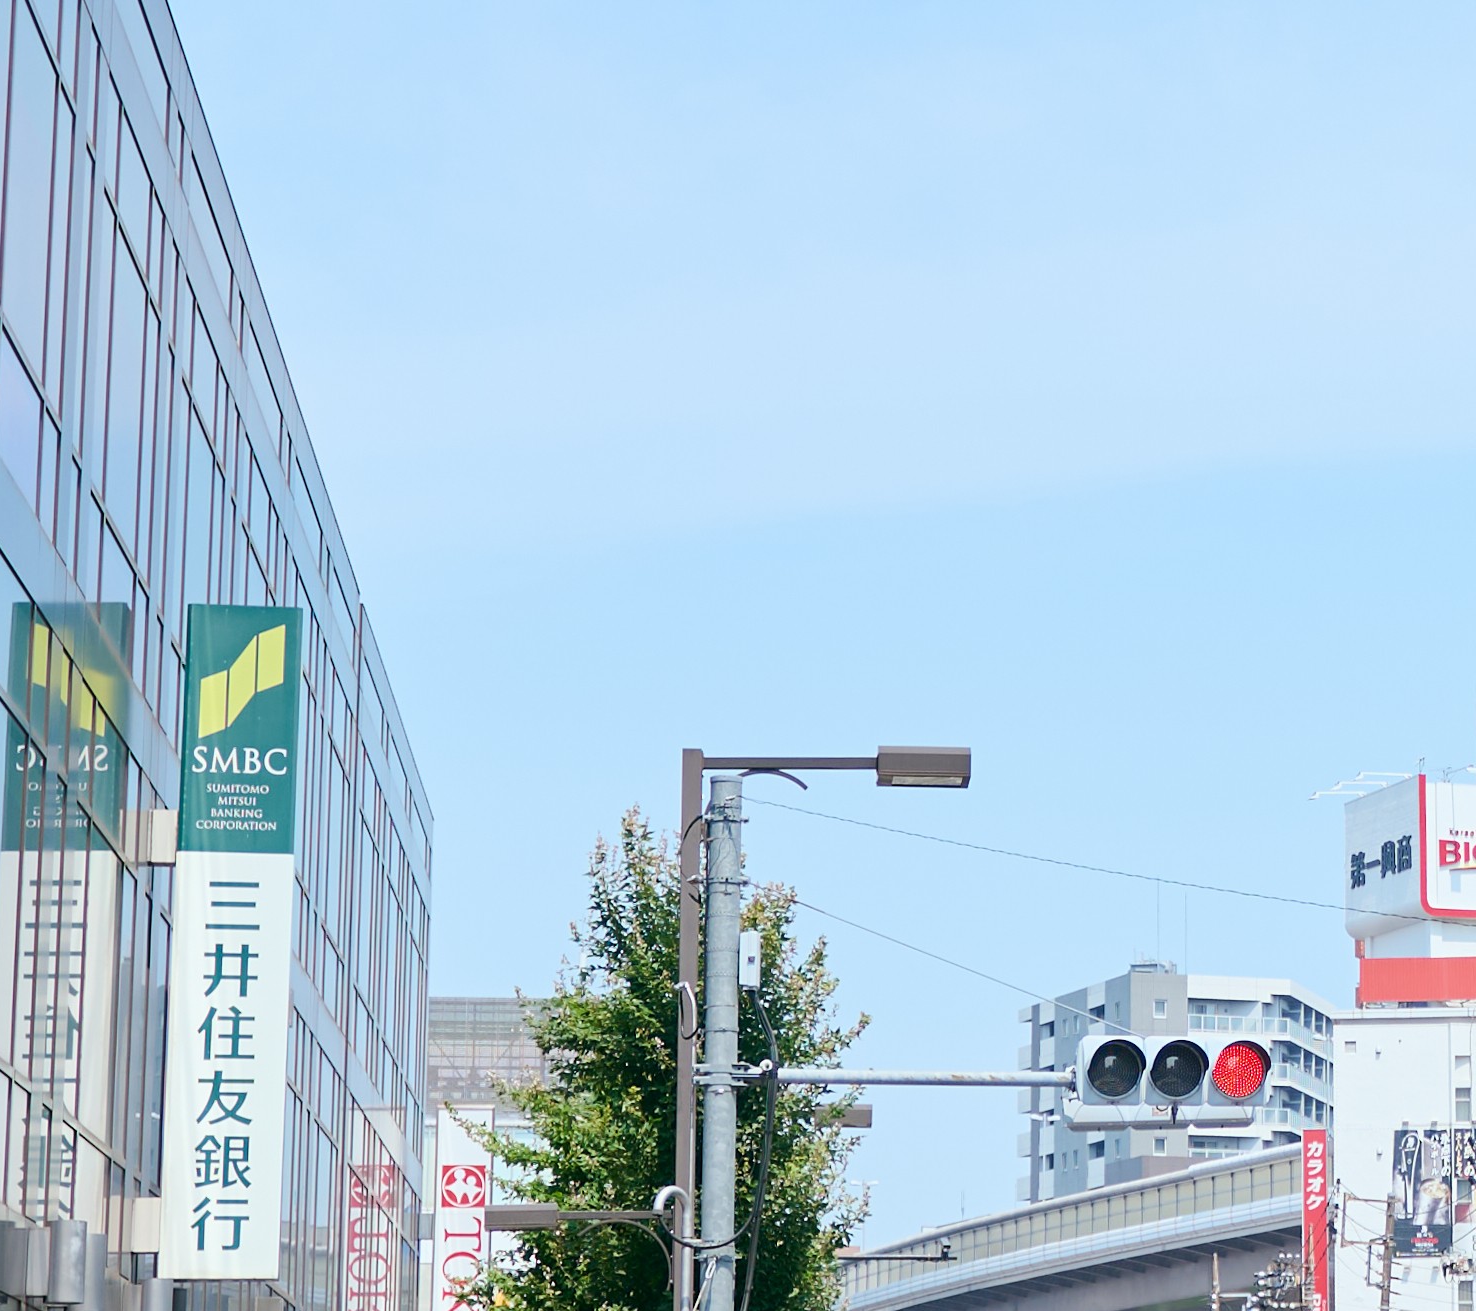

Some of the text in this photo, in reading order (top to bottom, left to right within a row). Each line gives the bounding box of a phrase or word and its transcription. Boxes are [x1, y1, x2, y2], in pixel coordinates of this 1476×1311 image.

[191, 745, 288, 776] SMBC
[205, 782, 270, 795] SUMITOMO
[217, 795, 257, 807] MITSUI
[210, 808, 264, 819] BANKING
[195, 819, 278, 831] CORPORATION
[1350, 835, 1413, 890] 第一興商
[190, 881, 260, 1252] 三井住友銀行
[1306, 1140, 1324, 1211] カラオケ
